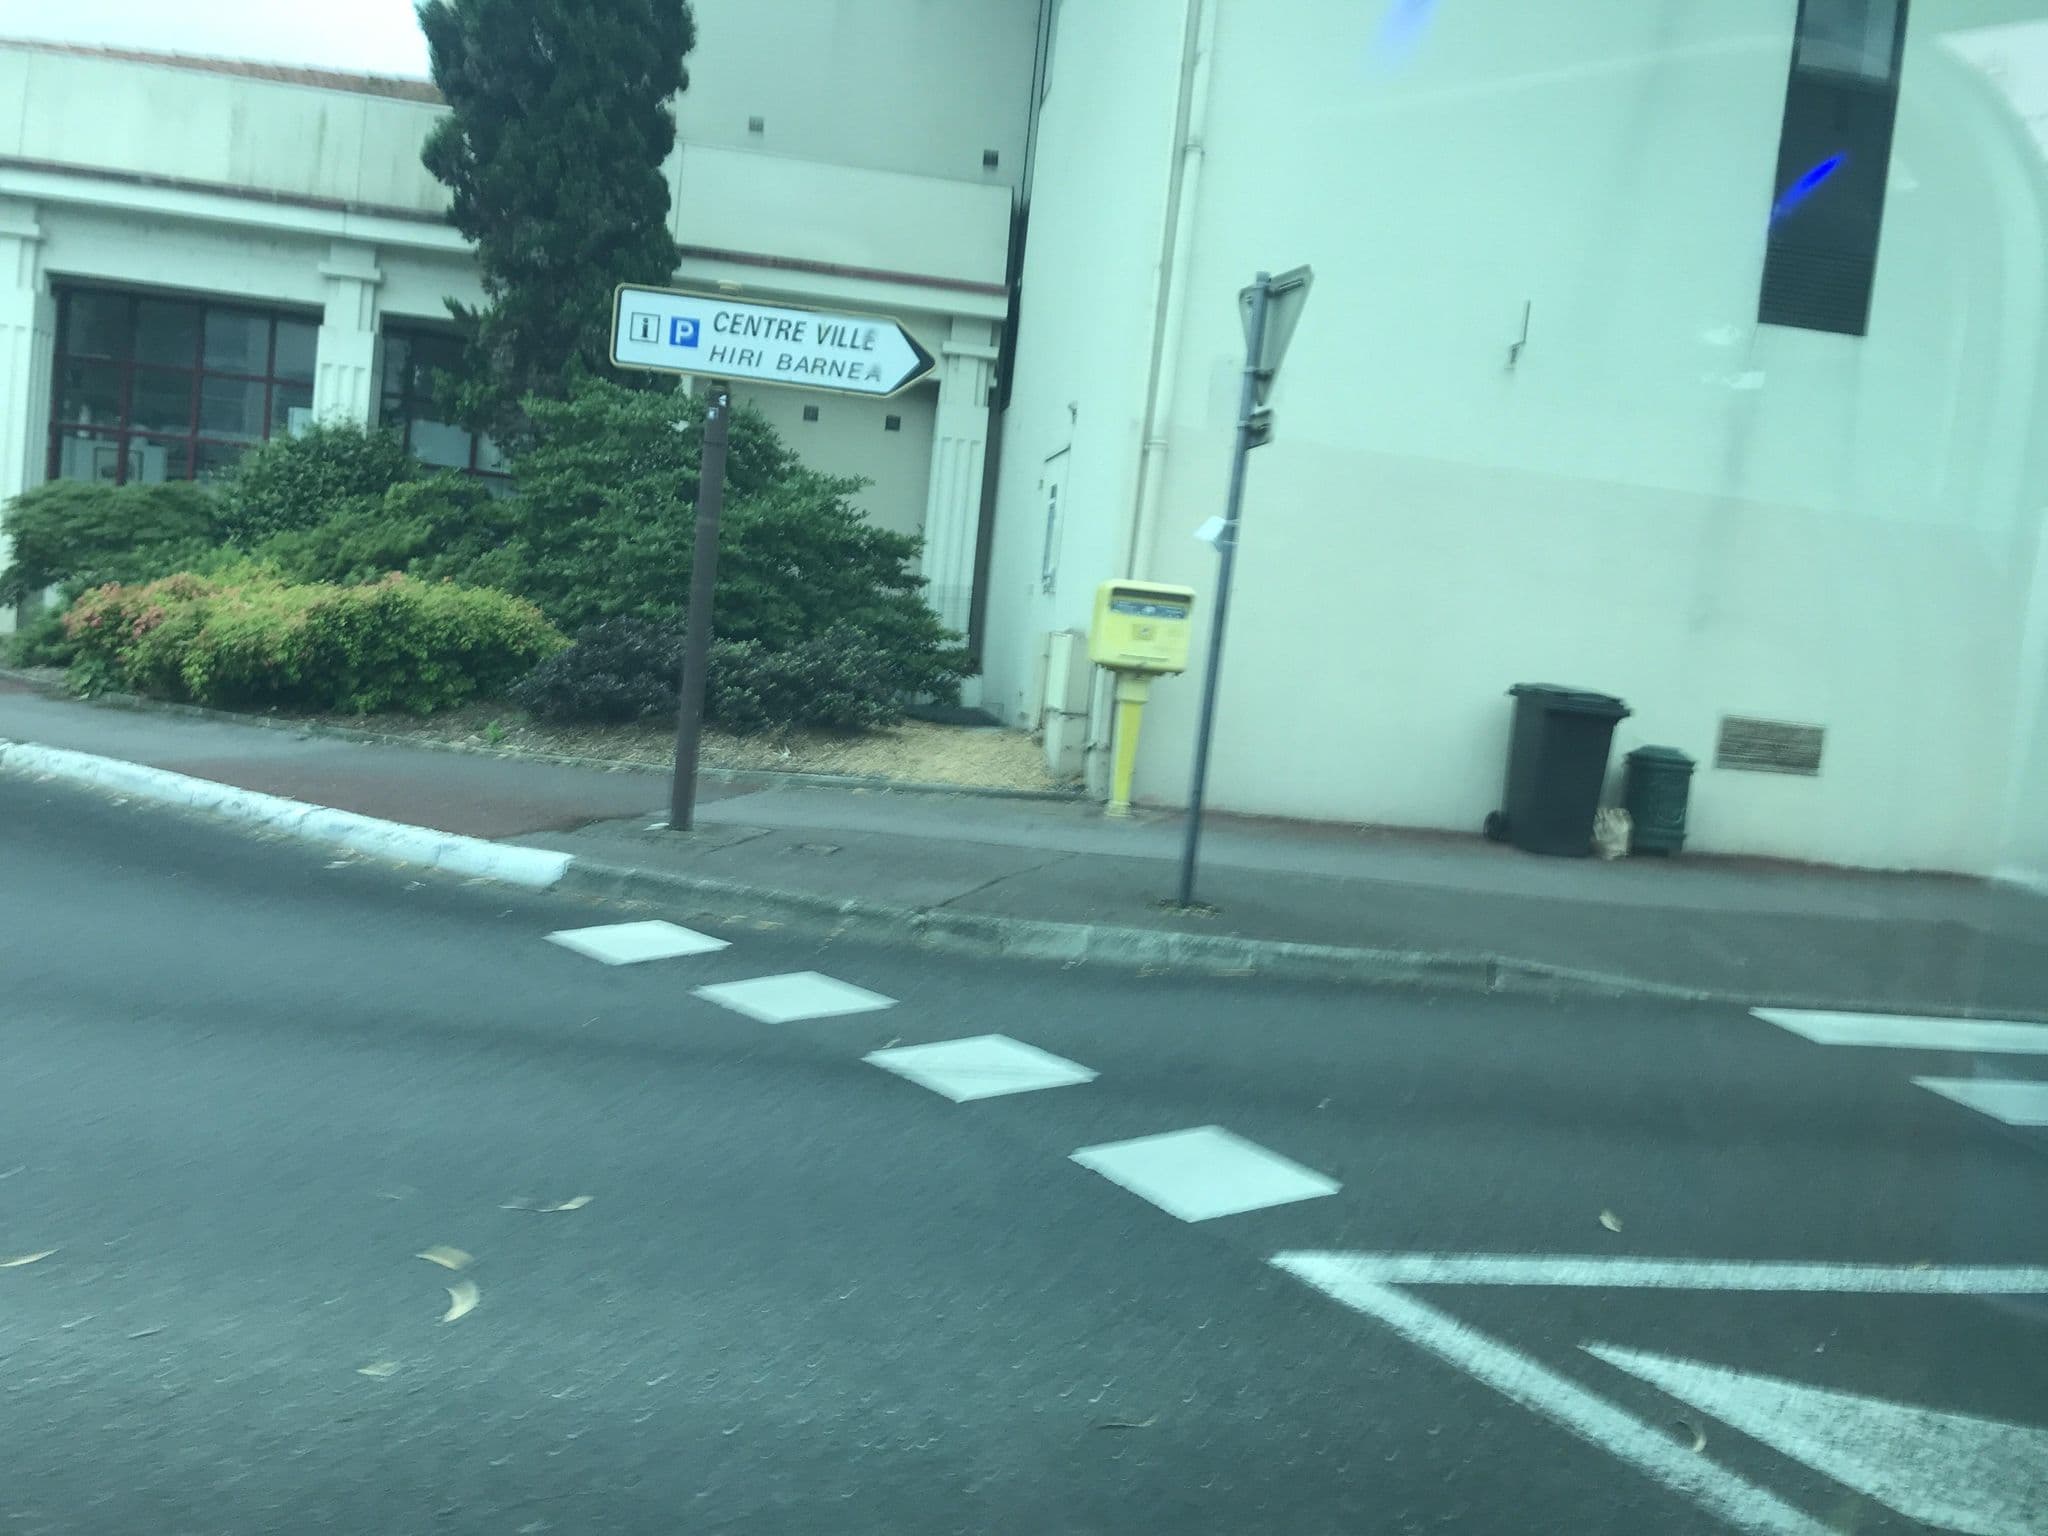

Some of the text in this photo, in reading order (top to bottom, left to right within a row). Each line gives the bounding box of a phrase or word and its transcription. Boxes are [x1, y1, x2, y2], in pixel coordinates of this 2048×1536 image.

[674, 319, 695, 342] P
[713, 311, 878, 351] CENTRE VILLE
[709, 345, 881, 383] HIRI BARNEA
